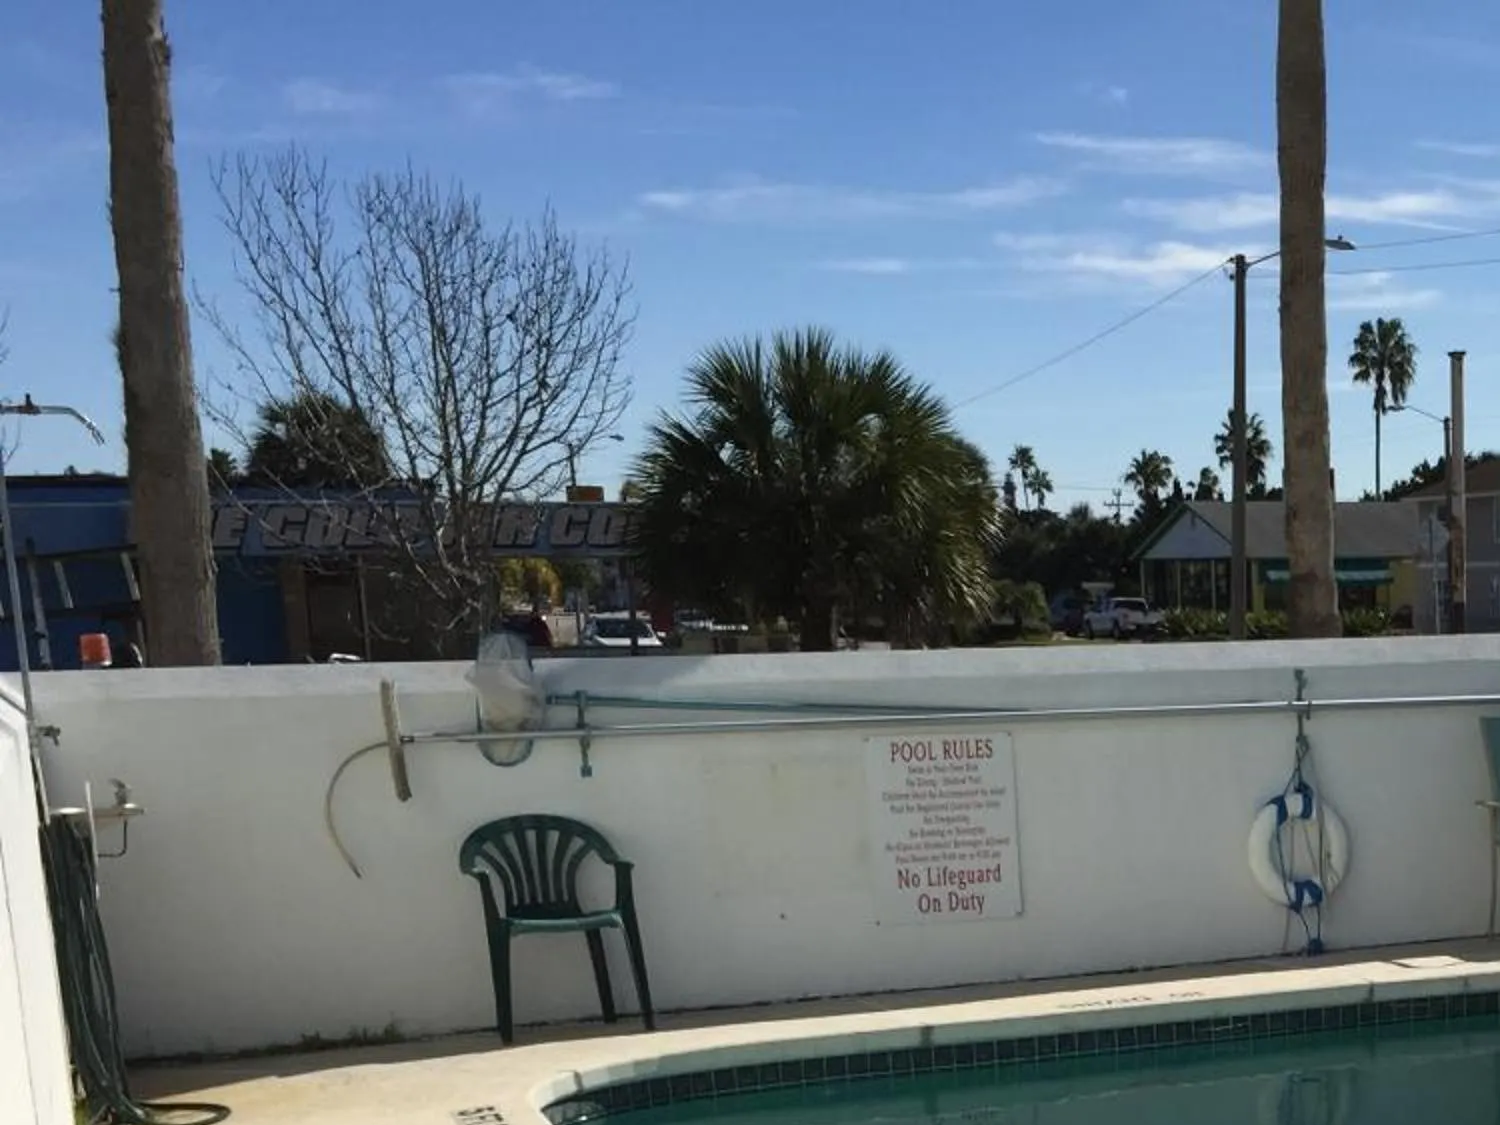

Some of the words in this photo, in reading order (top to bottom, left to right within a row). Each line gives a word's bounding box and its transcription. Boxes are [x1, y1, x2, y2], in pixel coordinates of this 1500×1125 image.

[891, 741, 937, 762] POOL
[943, 739, 993, 760] RULES
[898, 867, 920, 889] No
[927, 864, 1002, 889] Lifeguard
[918, 893, 942, 913] On
[948, 891, 984, 915] Duty
